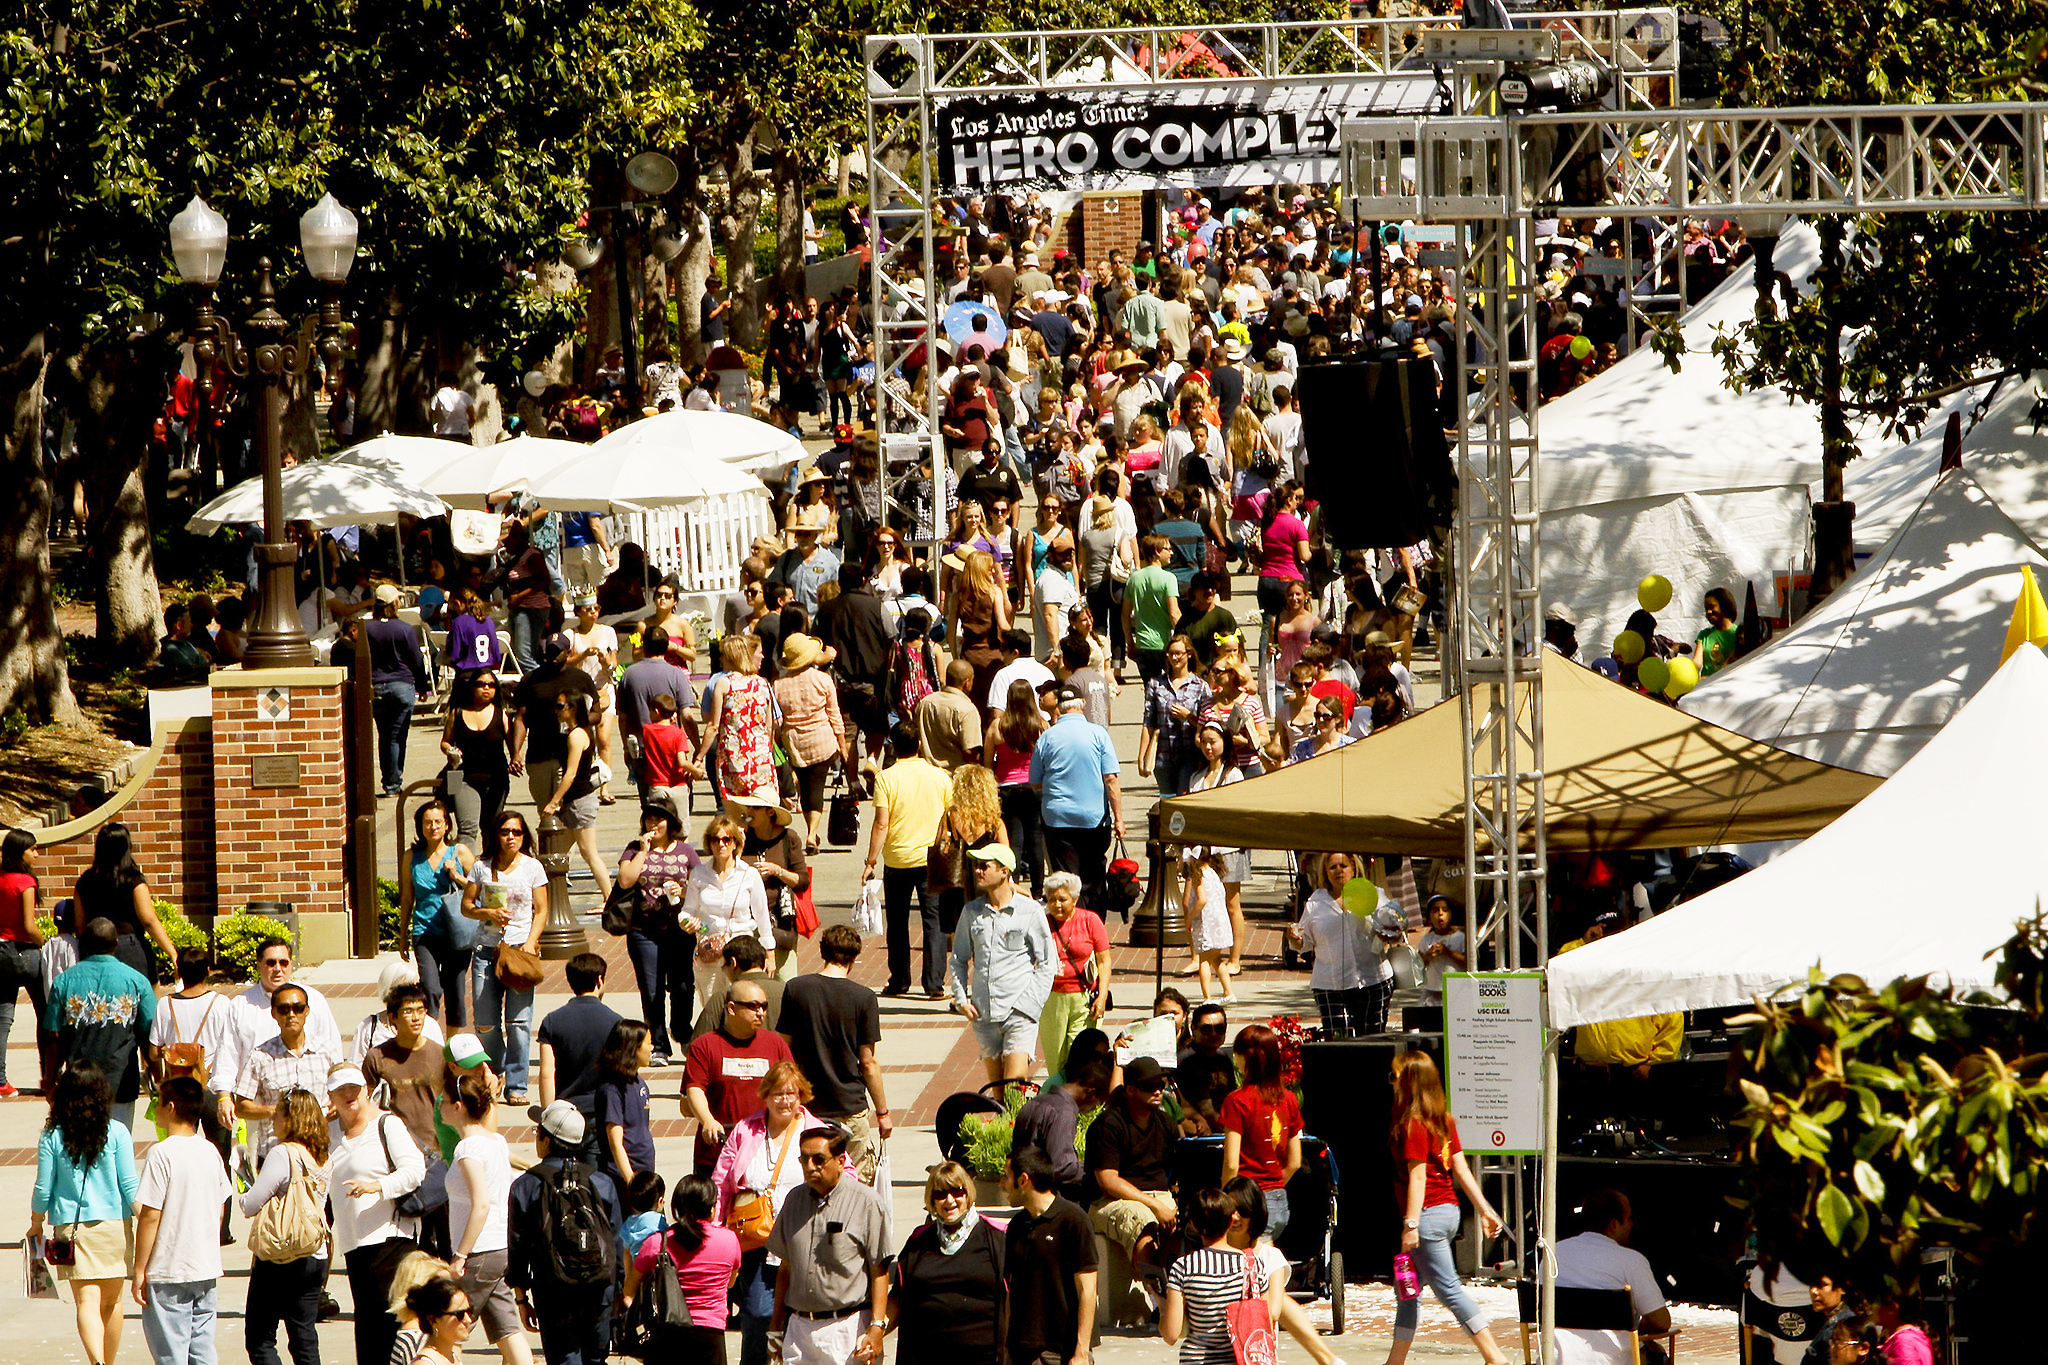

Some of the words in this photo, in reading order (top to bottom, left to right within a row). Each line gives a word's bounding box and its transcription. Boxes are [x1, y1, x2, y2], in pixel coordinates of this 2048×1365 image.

[950, 115, 989, 139] Los
[994, 108, 1077, 135] Angeles
[1081, 103, 1149, 126] Times
[952, 131, 1099, 185] HERO
[475, 634, 490, 663] 8
[1479, 988, 1507, 997] BOOKS
